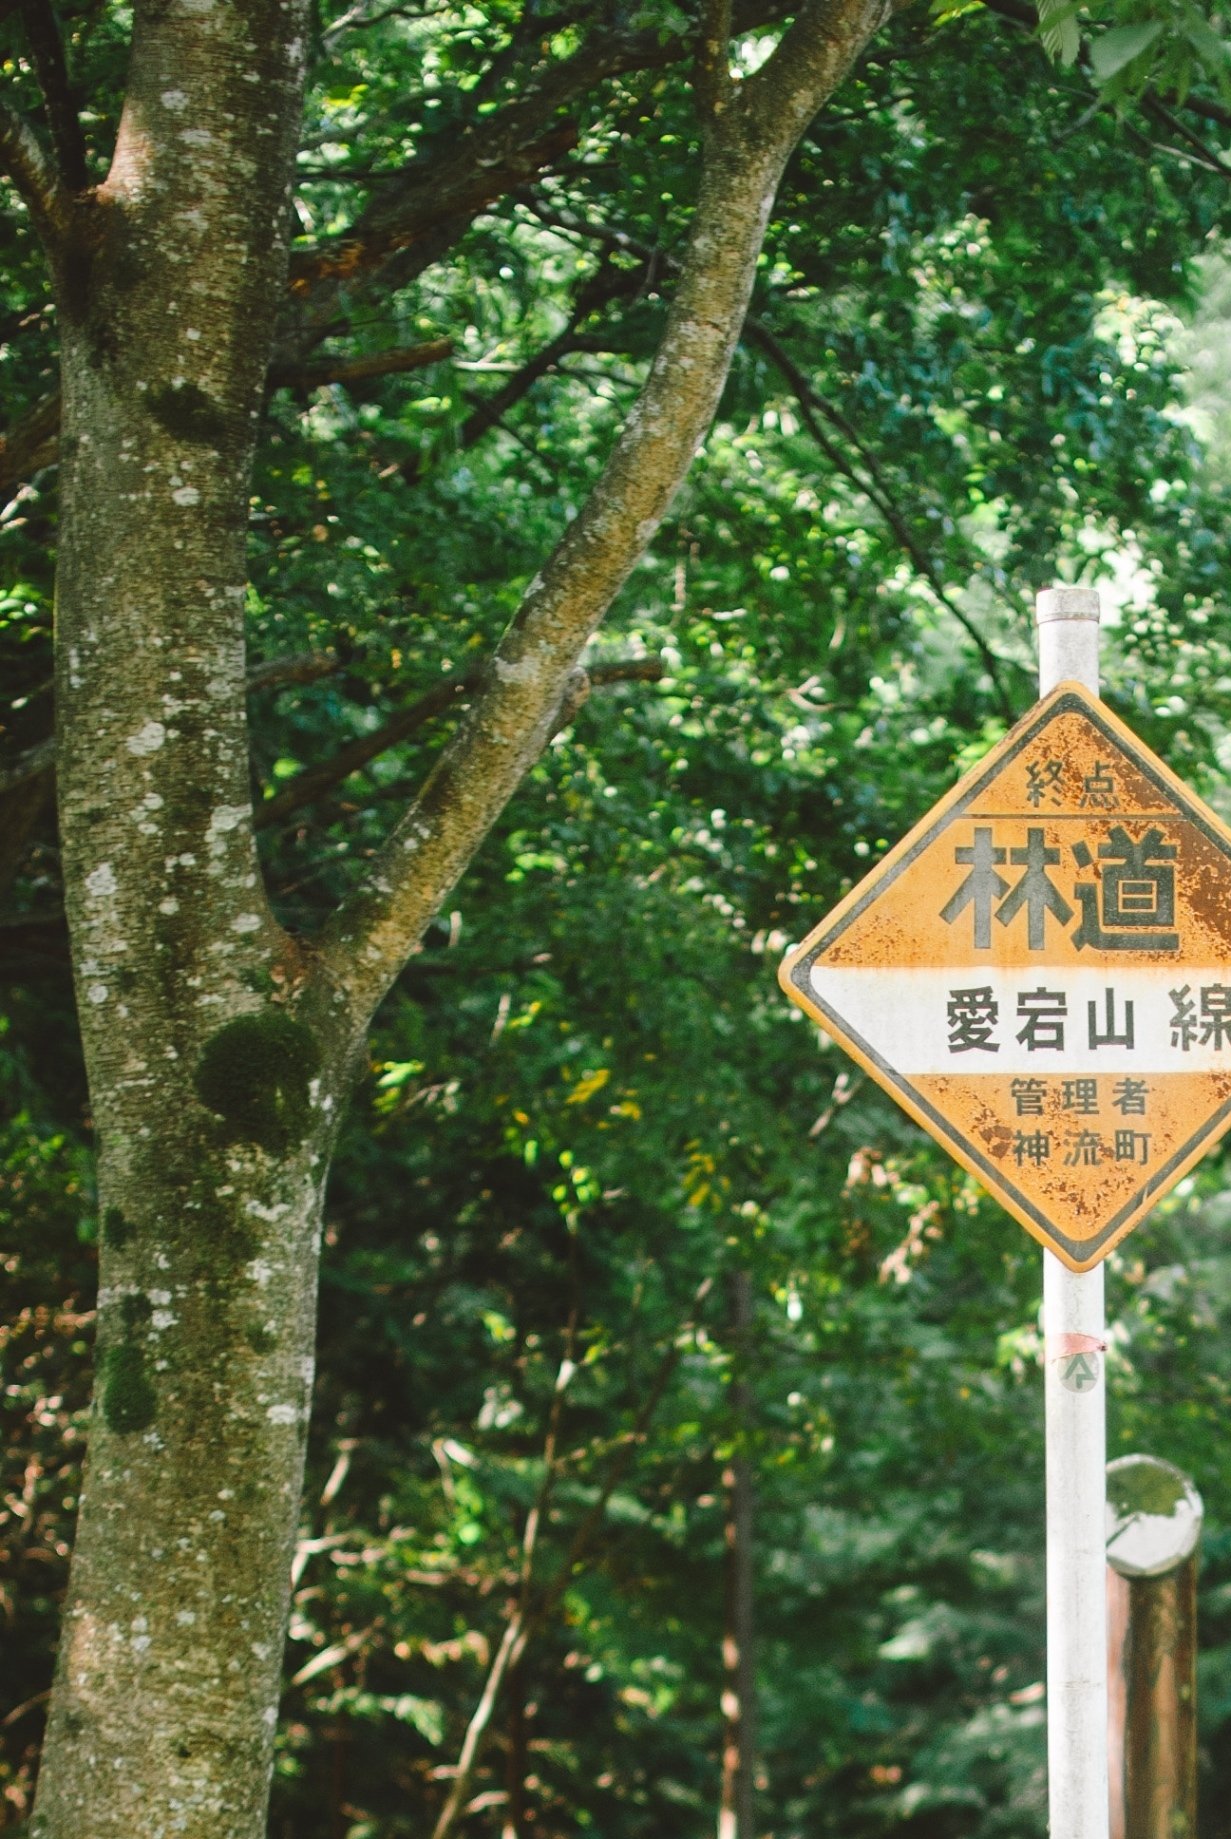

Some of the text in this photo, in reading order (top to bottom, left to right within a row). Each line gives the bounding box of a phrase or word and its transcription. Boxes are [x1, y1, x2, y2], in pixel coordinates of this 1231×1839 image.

[1025, 759, 1121, 809] 終点
[939, 827, 1180, 951] 林道
[1010, 1076, 1149, 1117] 管理者
[1012, 1127, 1153, 1167] 神流町
